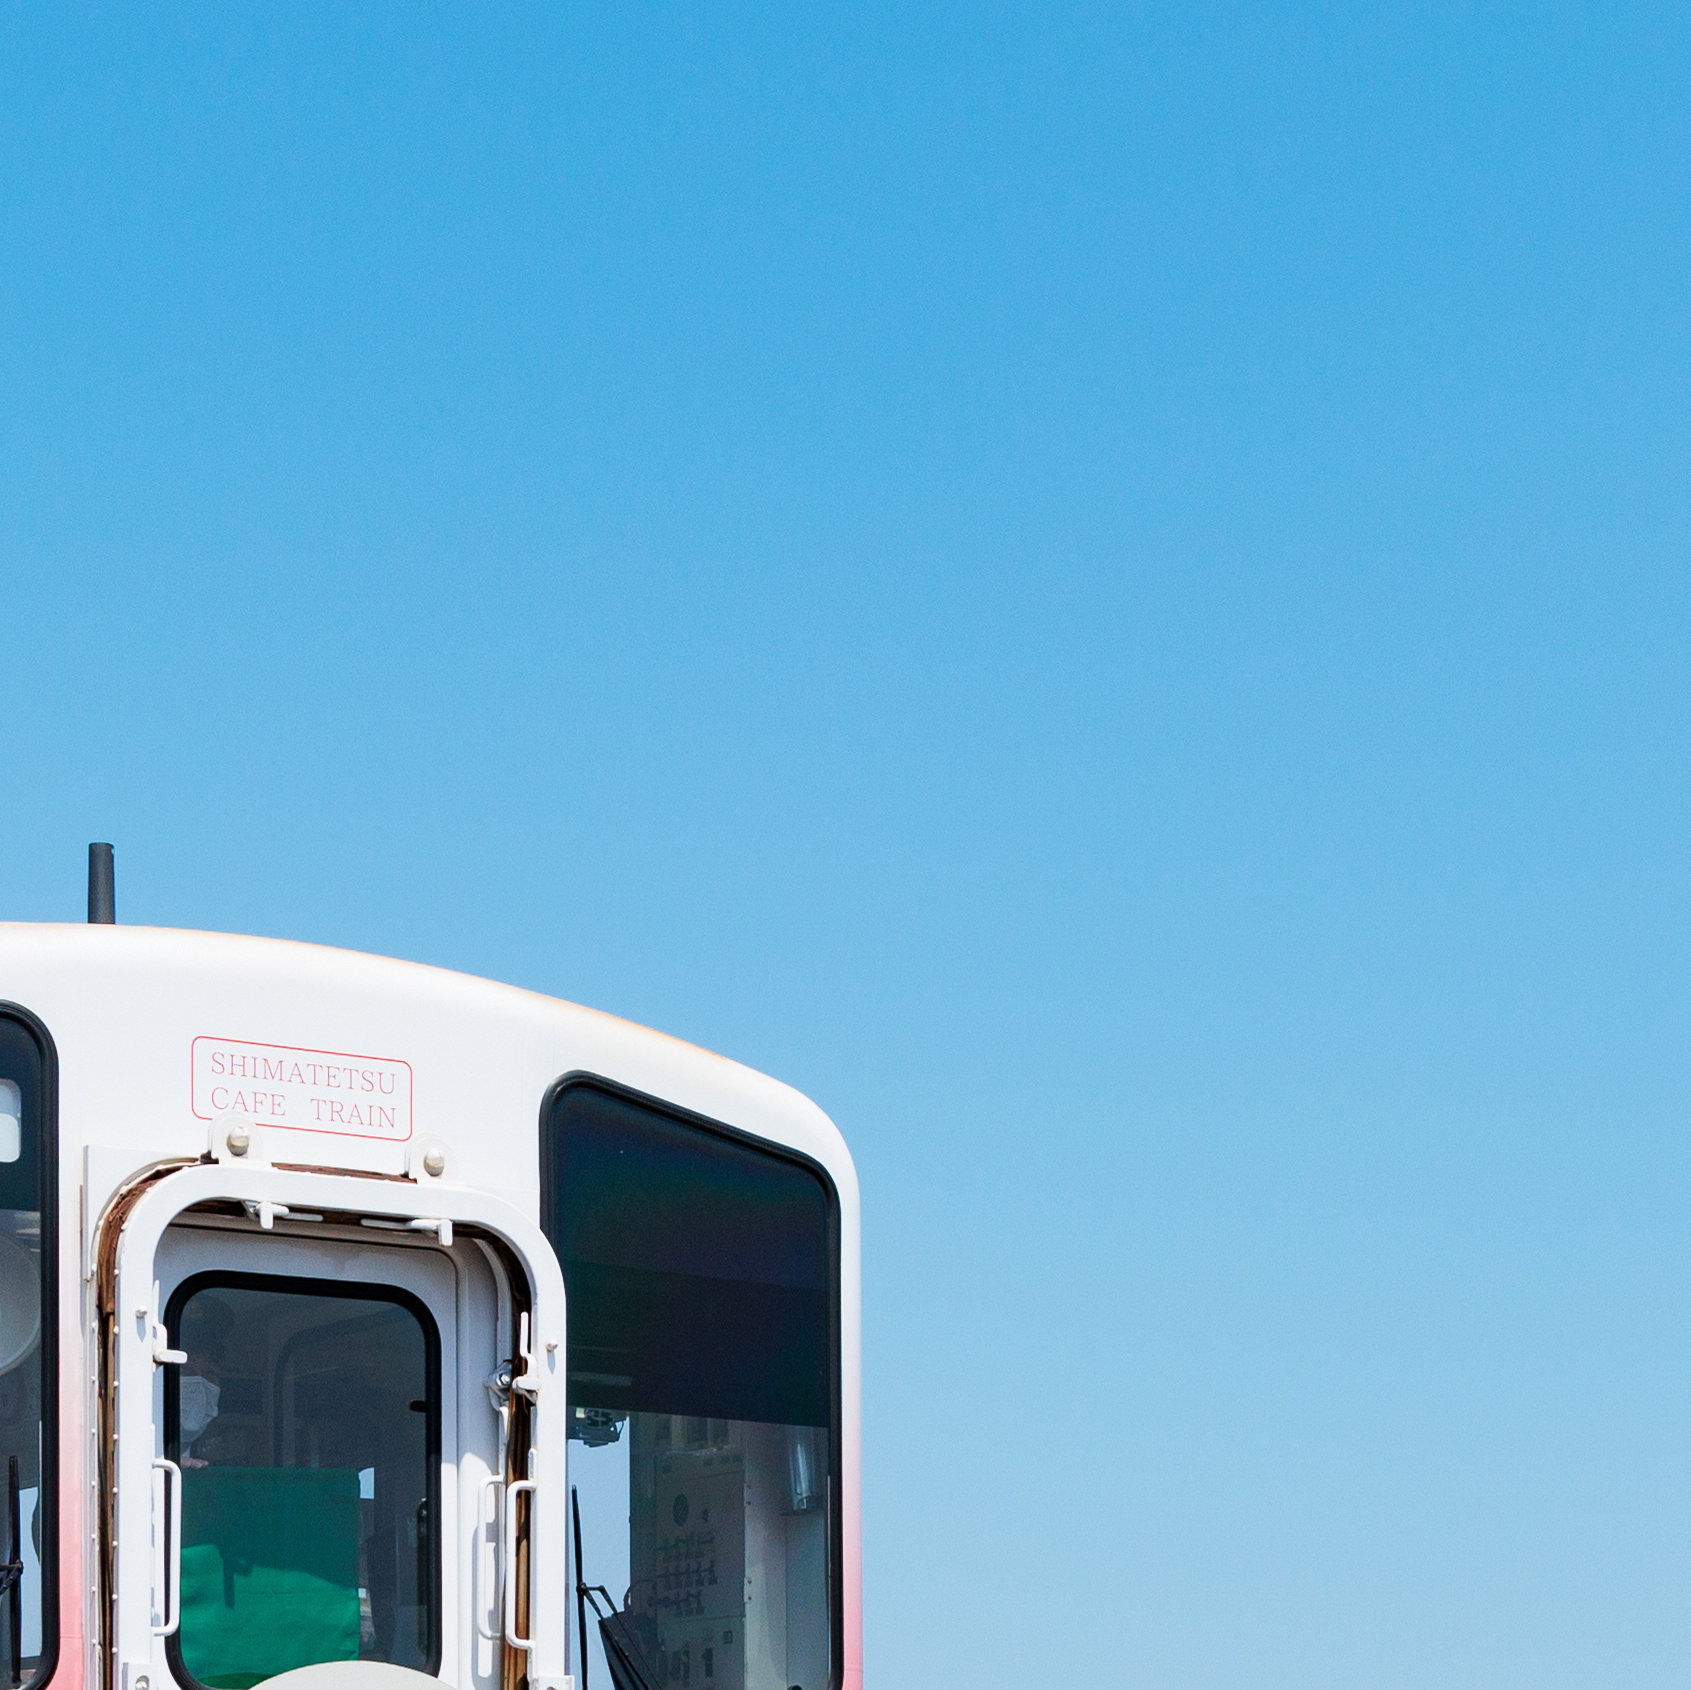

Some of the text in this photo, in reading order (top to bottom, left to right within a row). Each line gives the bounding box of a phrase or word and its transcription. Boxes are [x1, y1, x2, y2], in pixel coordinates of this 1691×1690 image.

[211, 1051, 396, 1095] SHIMATETSU
[211, 1087, 397, 1129] CAFE TRAIN
